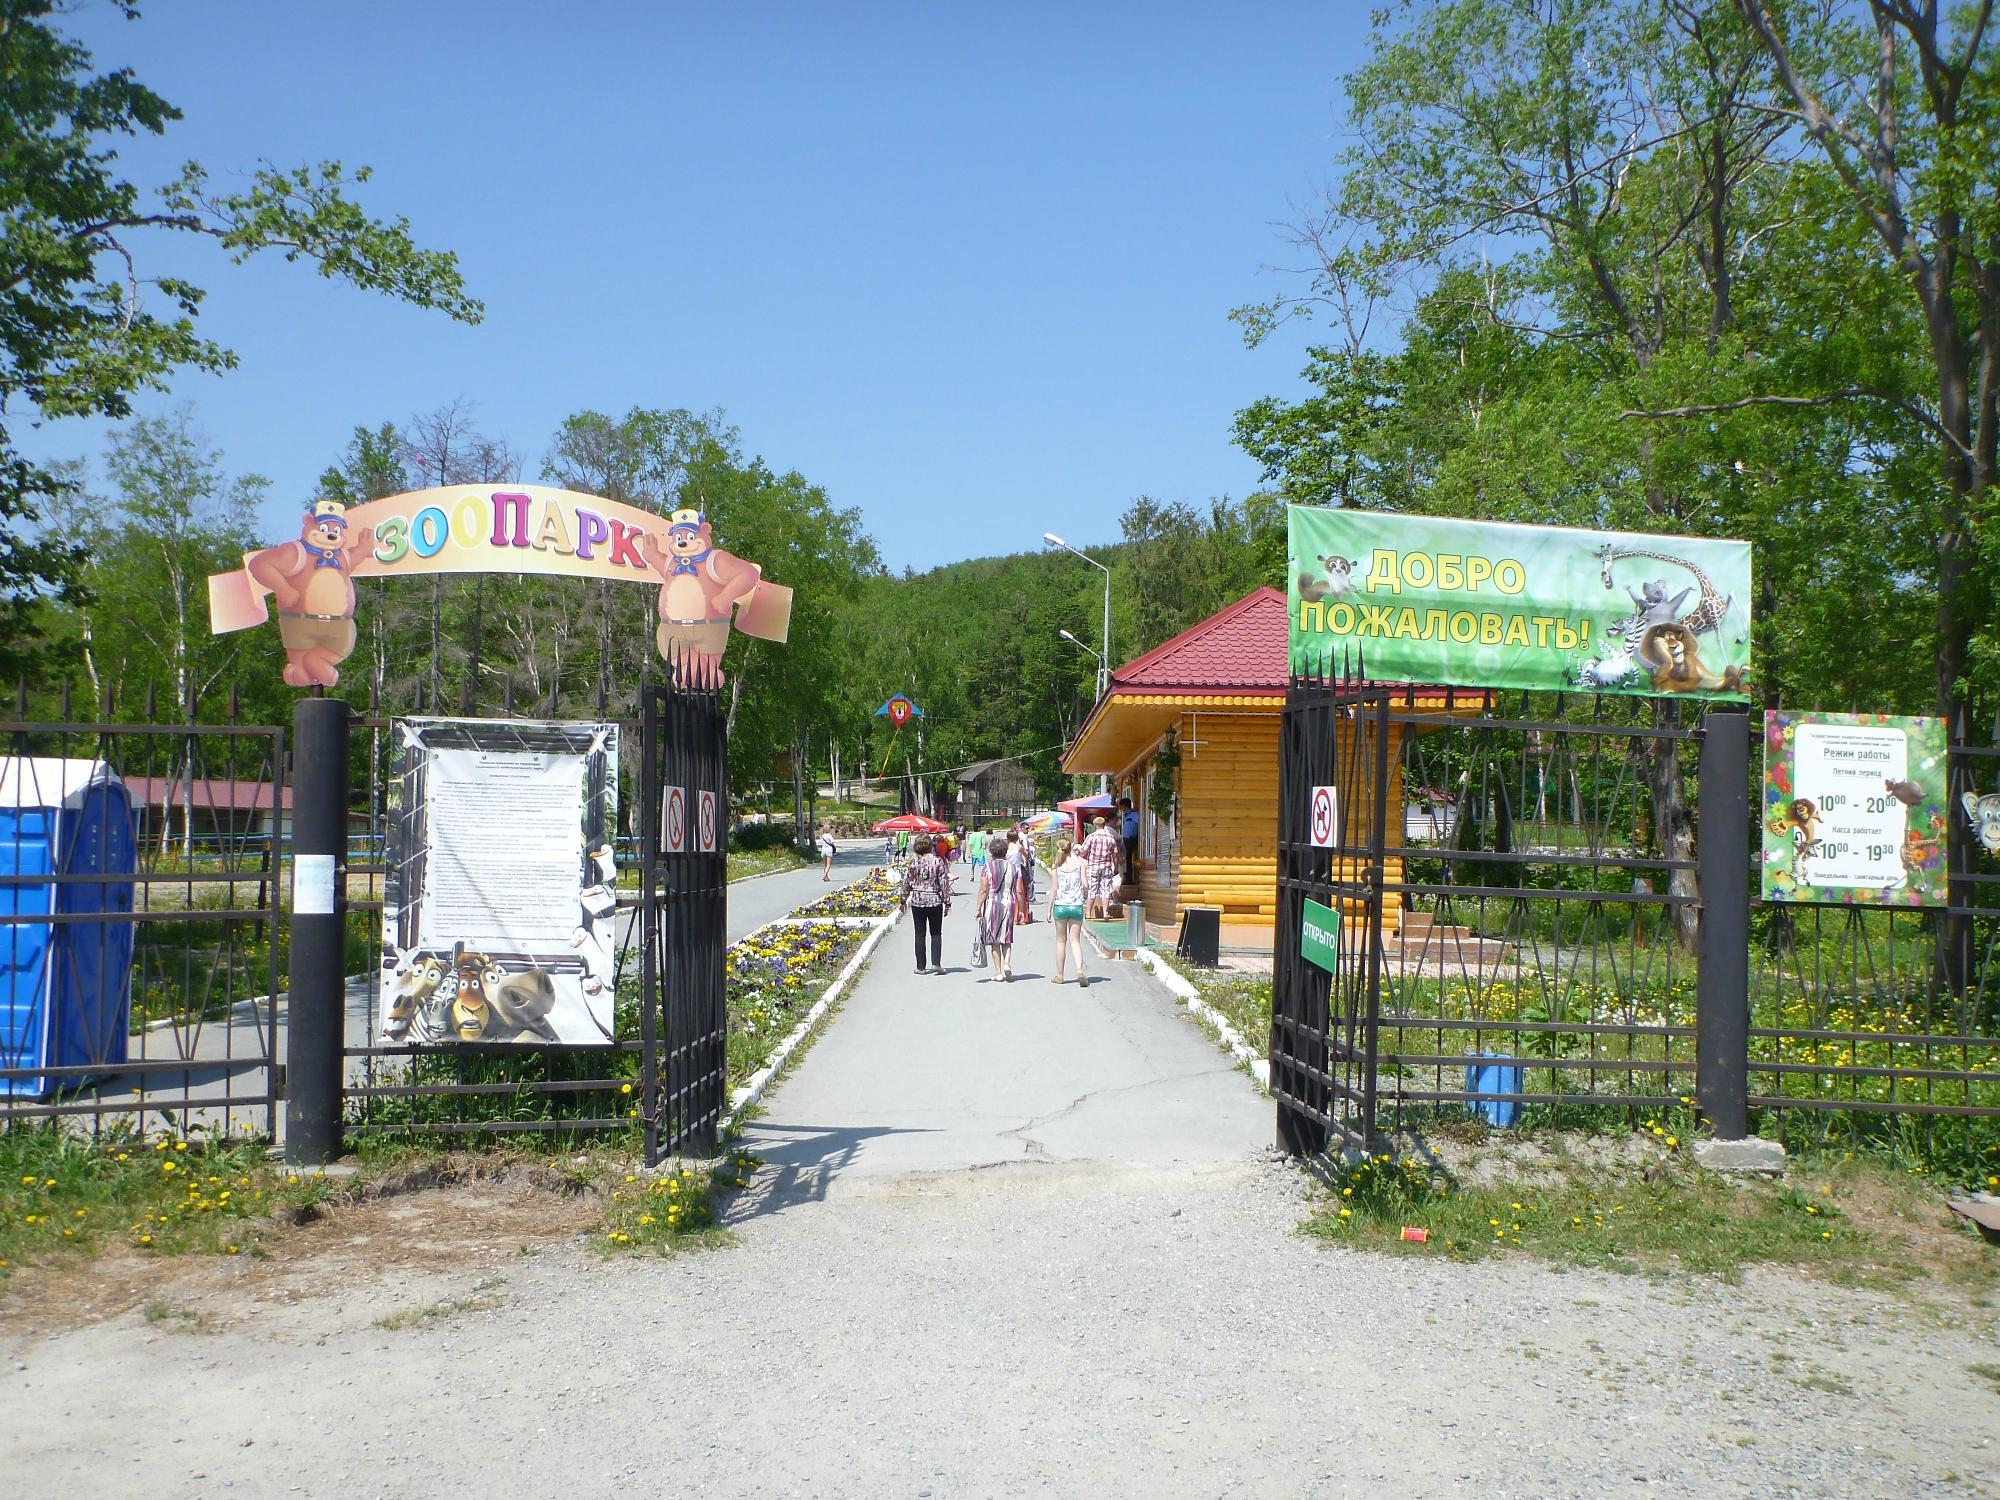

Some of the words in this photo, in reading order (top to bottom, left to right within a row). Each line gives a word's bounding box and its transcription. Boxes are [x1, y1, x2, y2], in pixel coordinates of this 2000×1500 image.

[373, 491, 648, 568] ЗООПАРК
[1365, 548, 1527, 595] ДОБРО
[1299, 599, 1591, 651] ПОЖАЛОВАТЬ!
[1823, 748, 1855, 758] Режим
[1857, 750, 1890, 760] работы
[1832, 767, 1856, 776] Летний
[1858, 769, 1882, 778] период
[1832, 826, 1851, 834] Касса
[1852, 827, 1882, 835] работает
[1303, 921, 1335, 949] ОТКРЫТО
